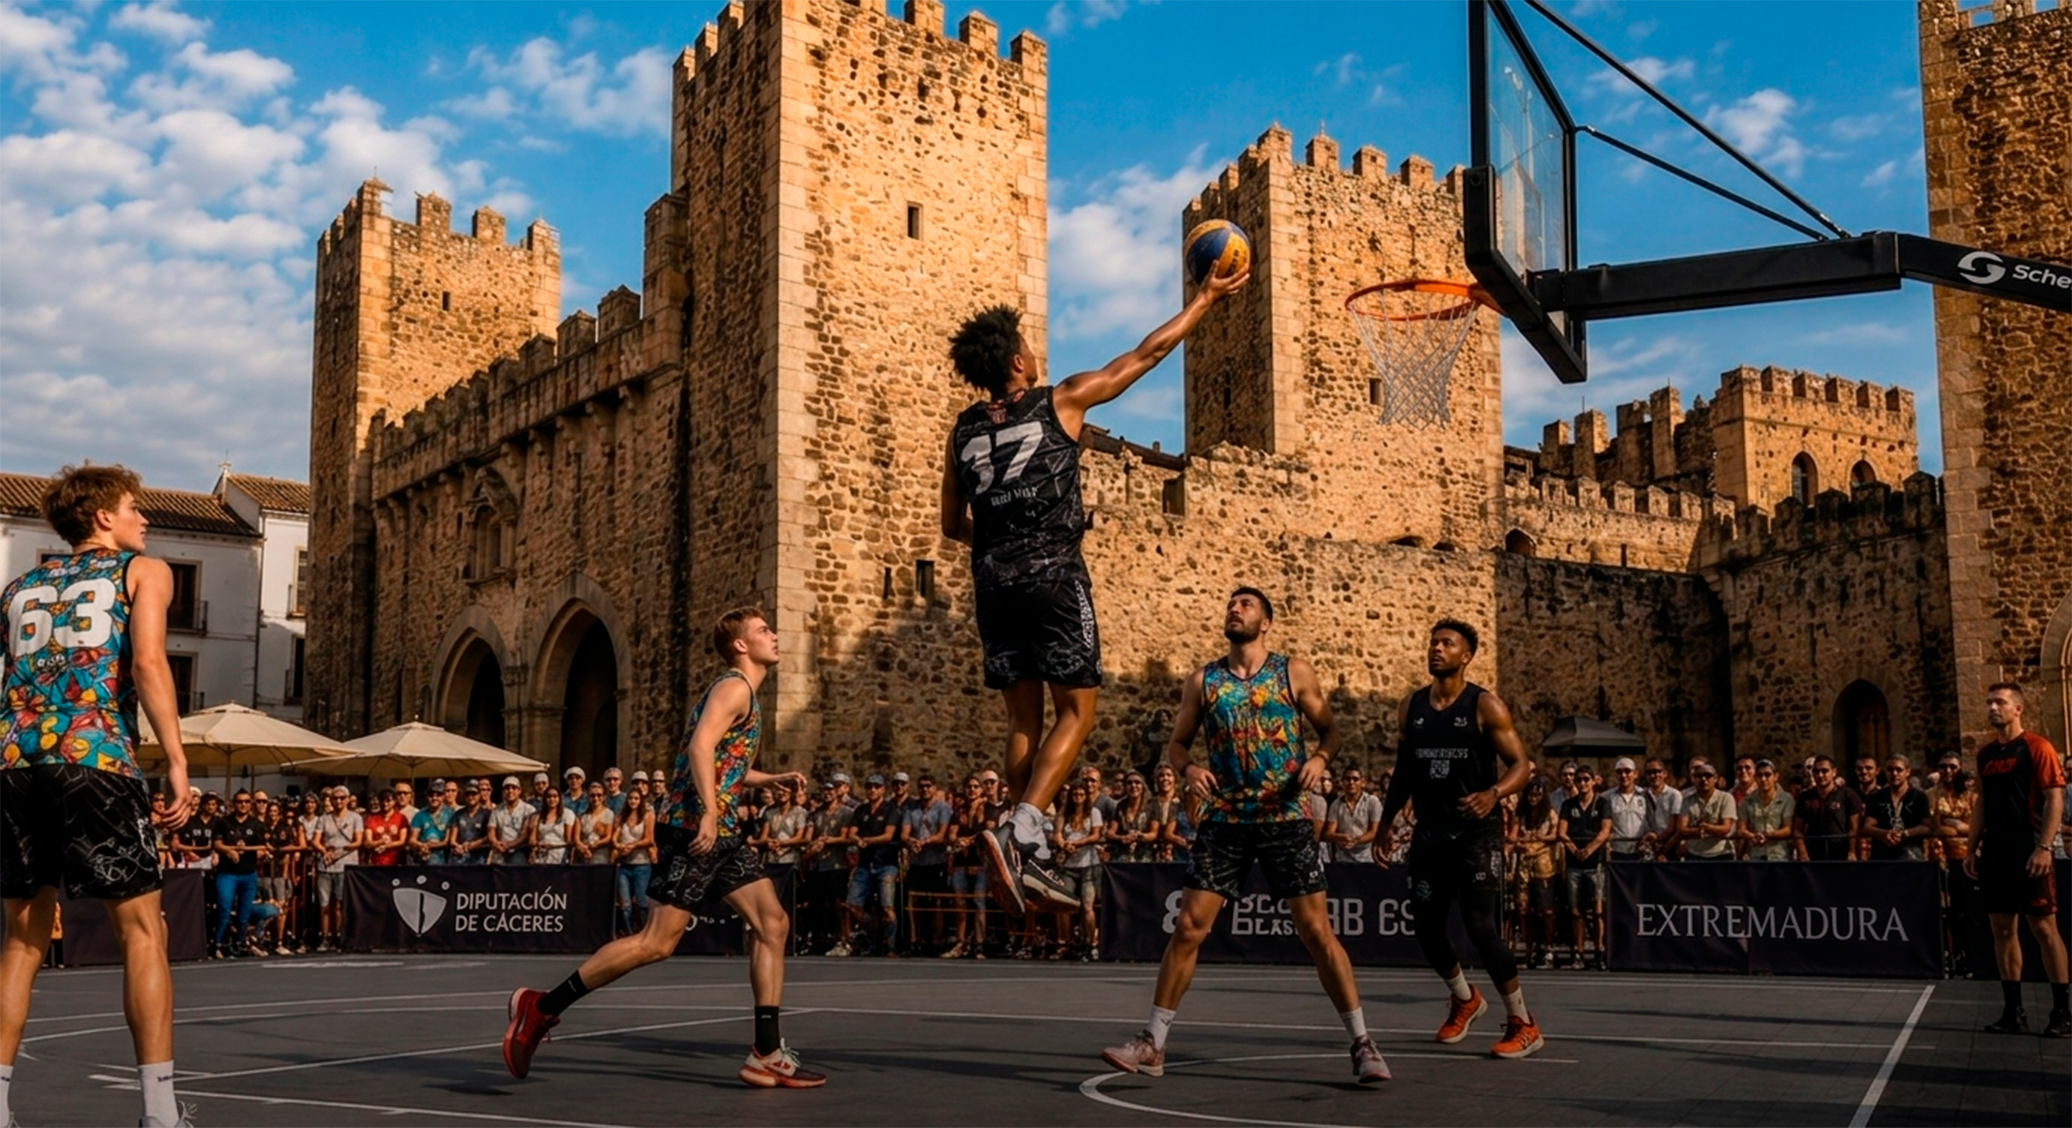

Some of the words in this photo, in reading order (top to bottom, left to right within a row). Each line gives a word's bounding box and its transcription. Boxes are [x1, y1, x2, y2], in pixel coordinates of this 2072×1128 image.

[2012, 264, 2072, 290] Sche
[8, 578, 116, 658] 63
[456, 886, 567, 910] DIPUTACIÓN
[455, 915, 479, 932] DE
[1636, 903, 1910, 942] EXTREMADURA
